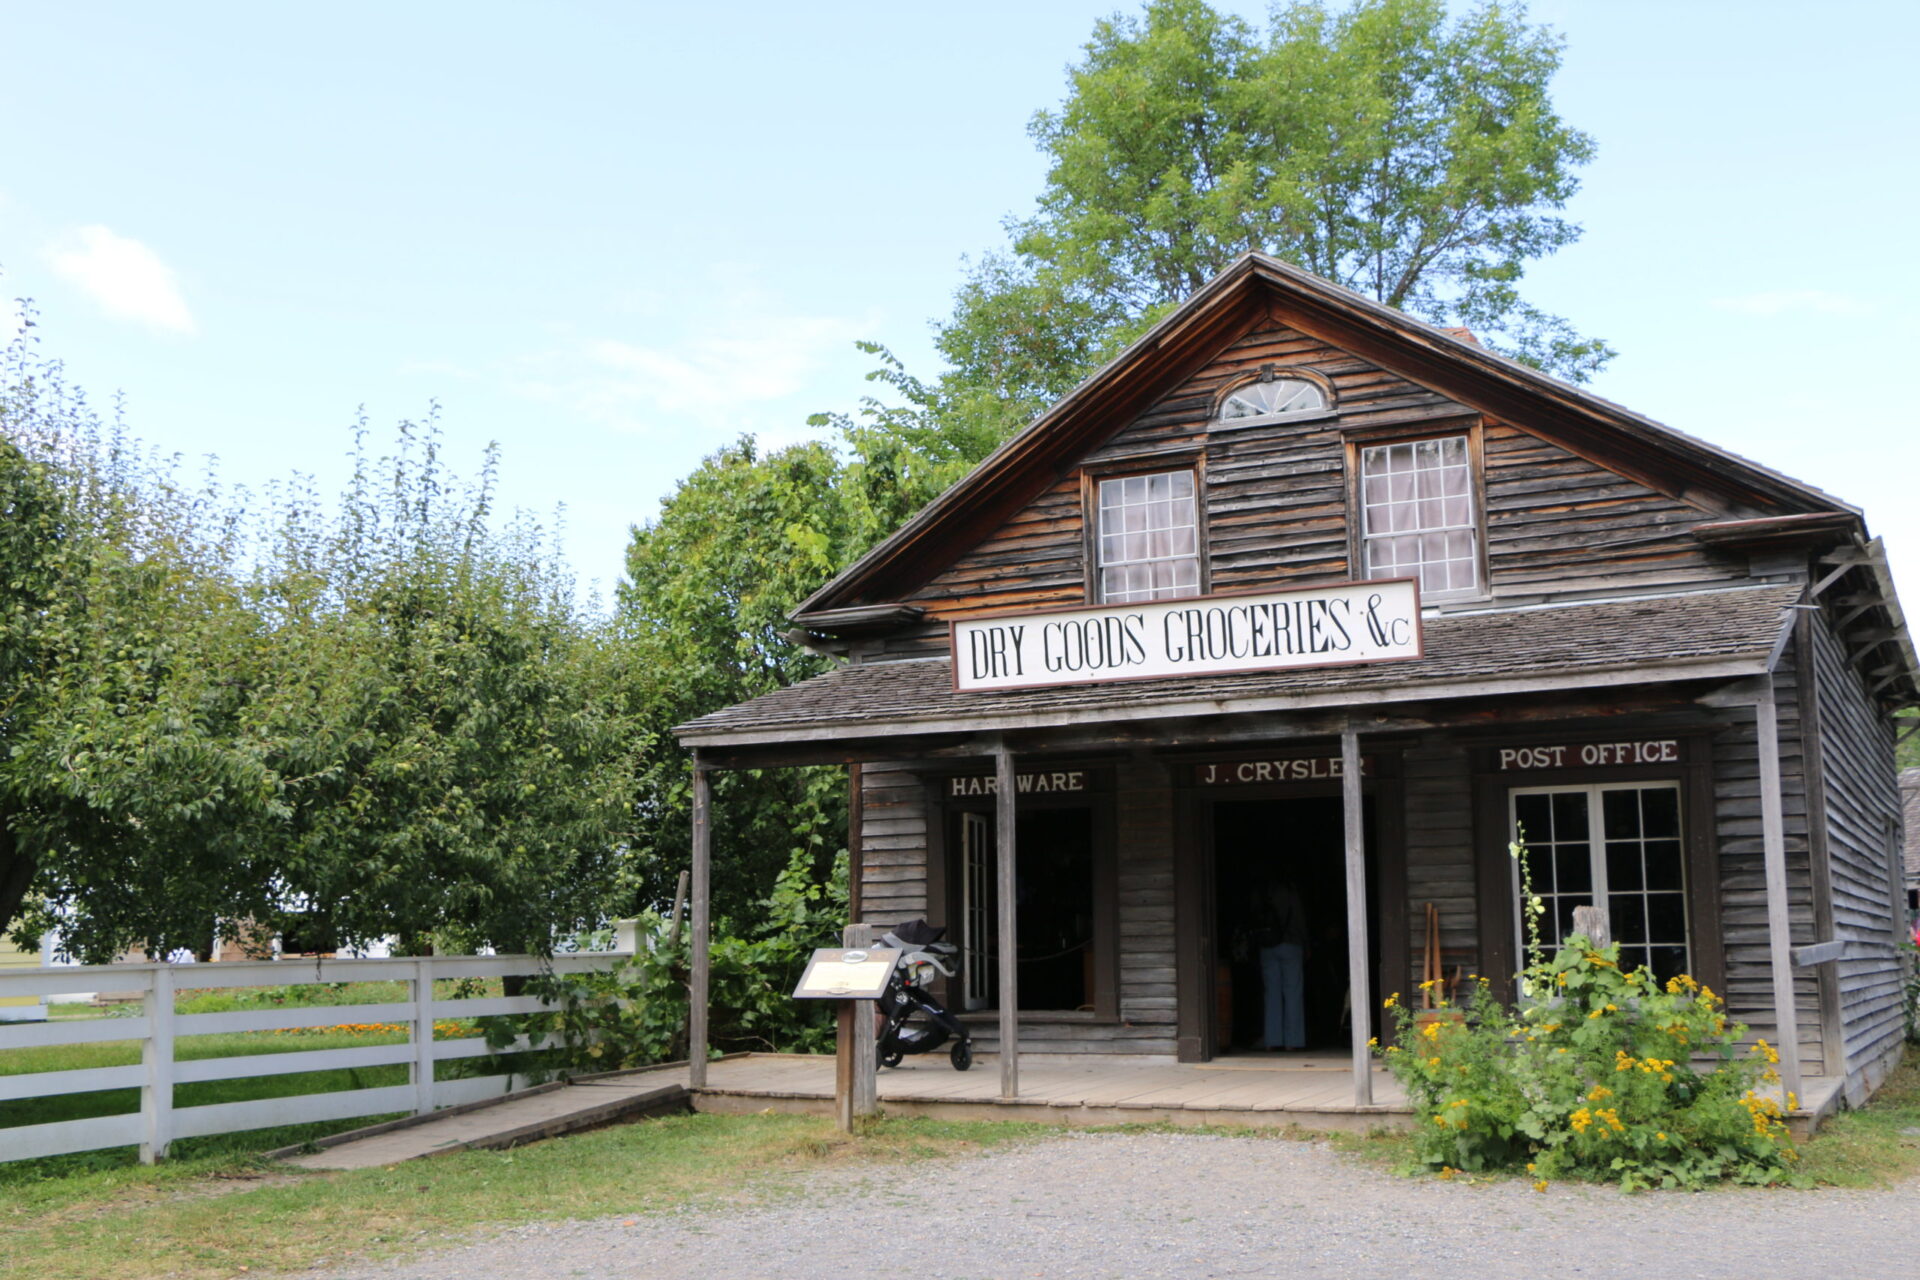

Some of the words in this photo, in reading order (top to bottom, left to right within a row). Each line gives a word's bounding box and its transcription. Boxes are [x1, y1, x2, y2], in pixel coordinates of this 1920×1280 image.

[970, 625, 1025, 679] DRY
[1043, 613, 1146, 673] GOODS
[1164, 598, 1351, 663] GROCERIES
[1500, 746, 1566, 769] POST
[1581, 740, 1677, 764] OFFICE
[952, 772, 1083, 796] HARWARE
